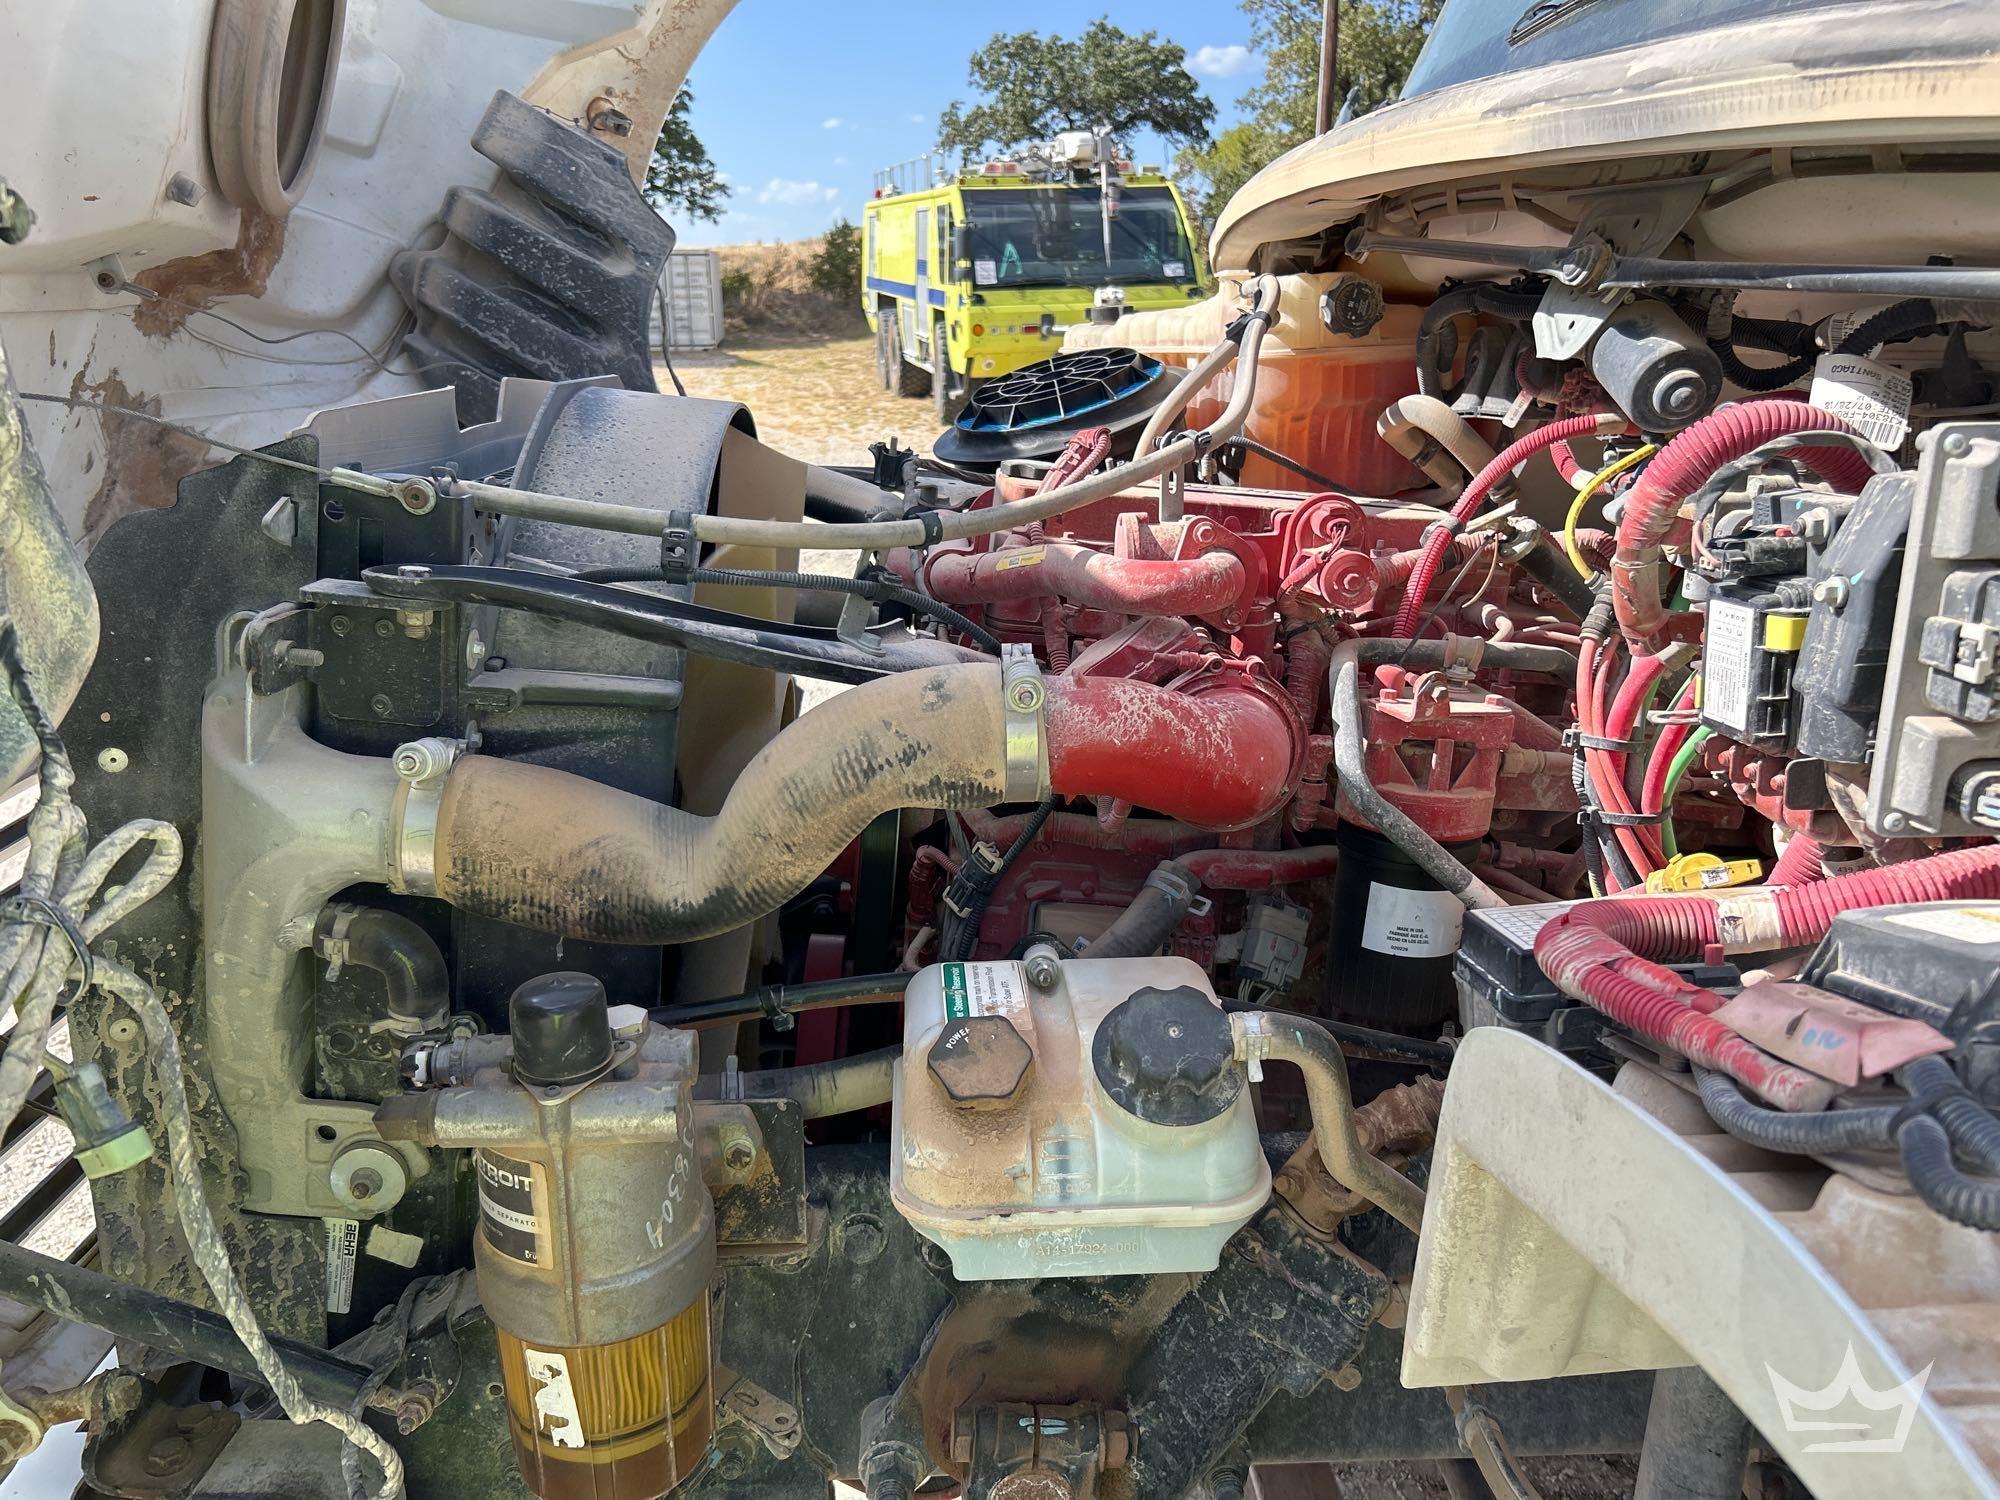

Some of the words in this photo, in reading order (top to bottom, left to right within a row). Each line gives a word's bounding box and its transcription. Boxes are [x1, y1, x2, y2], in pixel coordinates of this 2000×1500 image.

[1831, 364, 1882, 381] SANTIAGO
[951, 966, 963, 991] Reservoir
[497, 1210, 536, 1228] SEPARATO
[343, 1223, 357, 1257] BEHR
